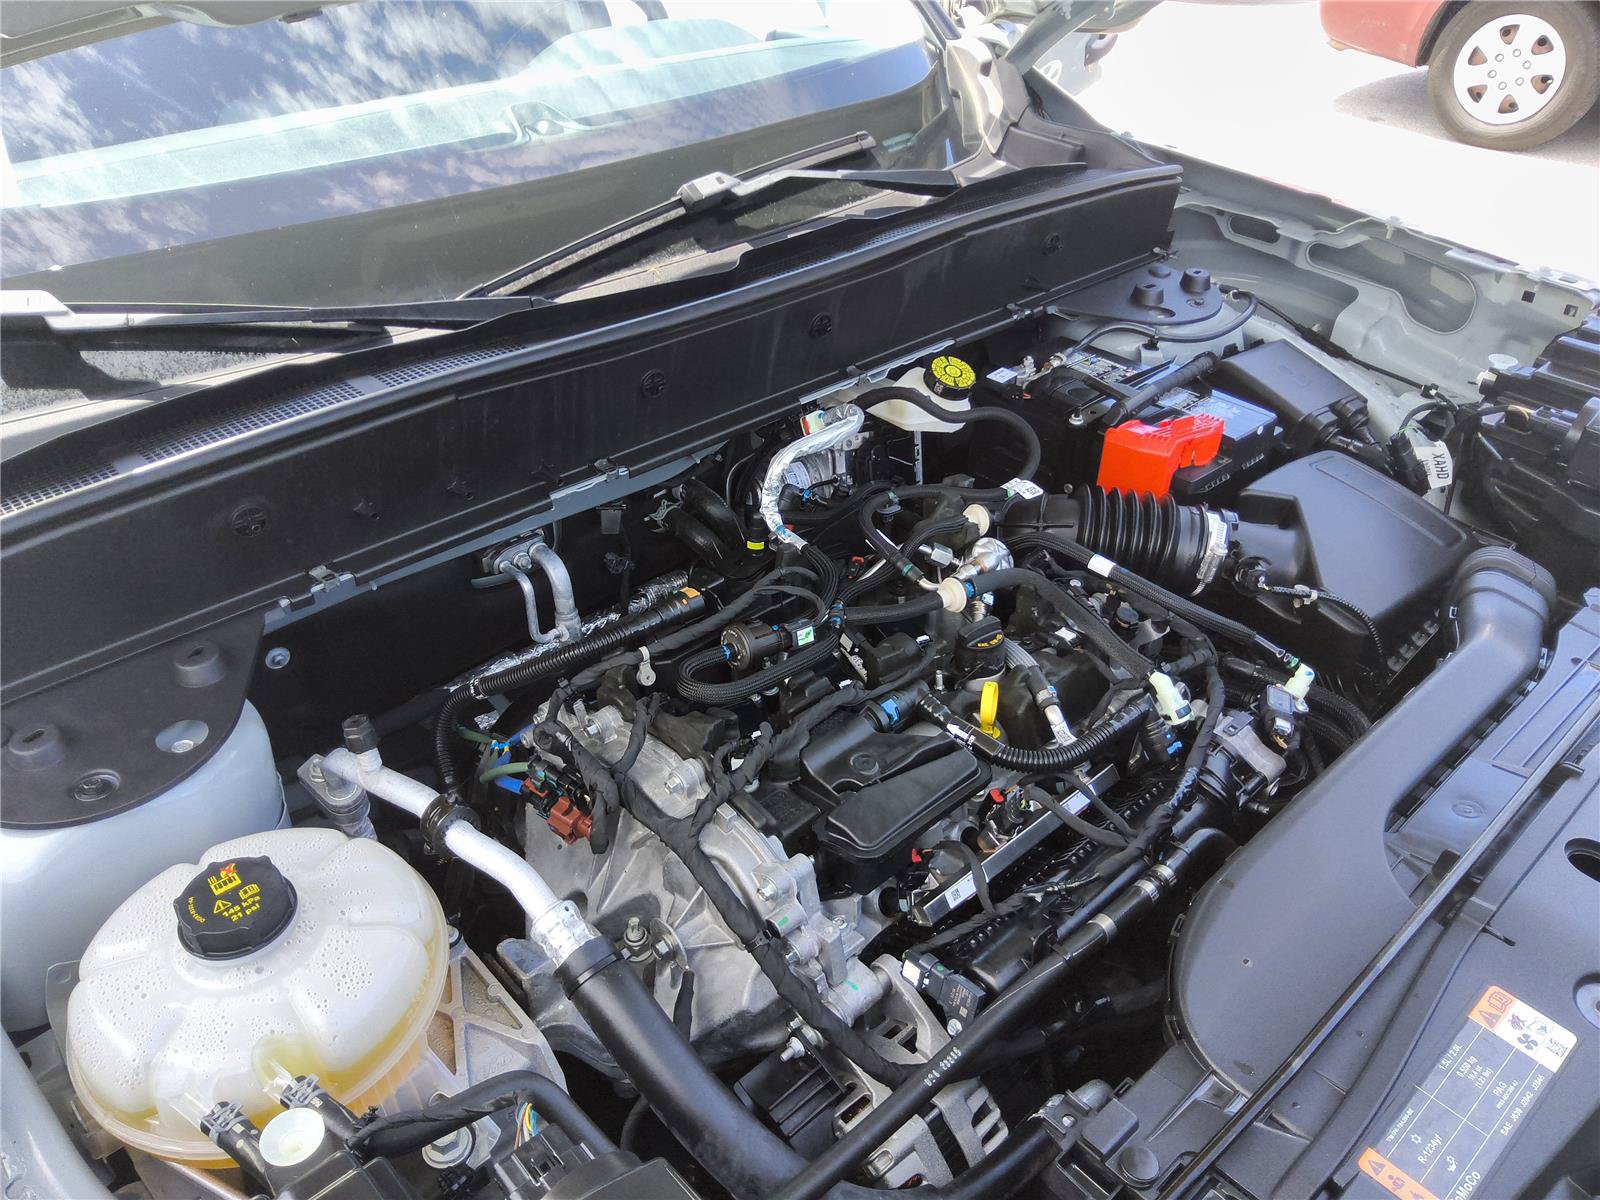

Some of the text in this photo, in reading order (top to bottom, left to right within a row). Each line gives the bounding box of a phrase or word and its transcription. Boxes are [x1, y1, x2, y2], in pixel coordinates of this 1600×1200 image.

[1431, 453, 1449, 479] XAHD
[223, 896, 261, 917] 145 kPa
[230, 903, 260, 922] 21 psi
[1450, 1044, 1462, 1057] 2.0L
[1492, 1081, 1507, 1096] PAG
[1500, 1121, 1513, 1136] SAE
[1418, 1133, 1442, 1164] R-1234yf
[1449, 1171, 1481, 1200] oMoCo
